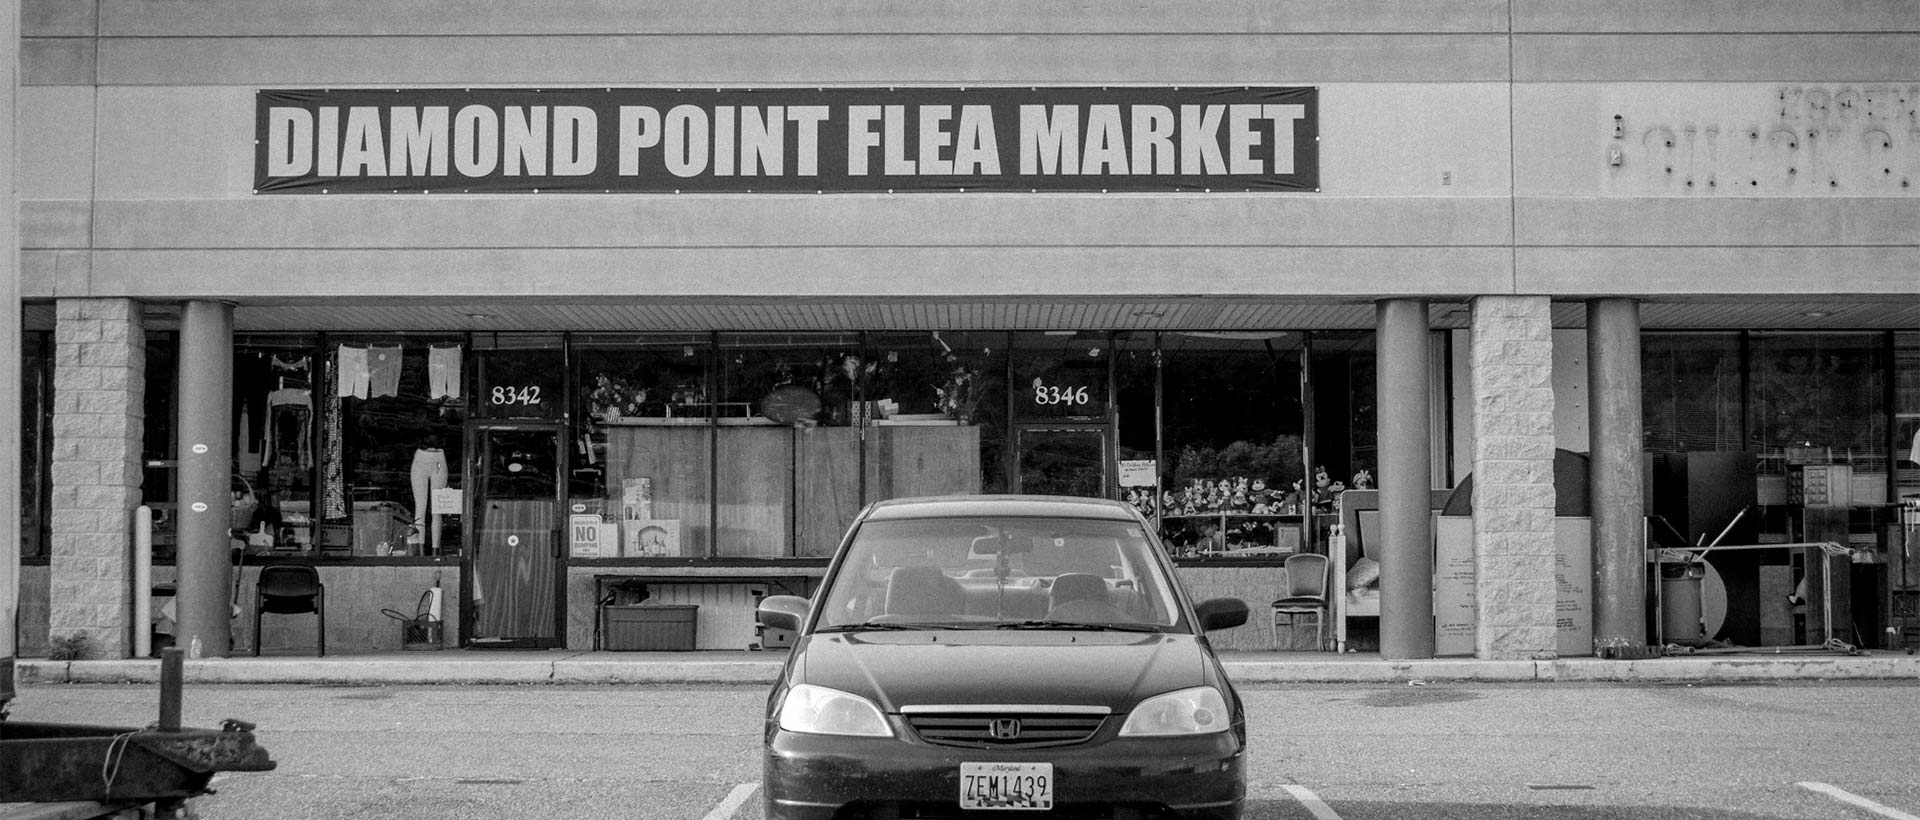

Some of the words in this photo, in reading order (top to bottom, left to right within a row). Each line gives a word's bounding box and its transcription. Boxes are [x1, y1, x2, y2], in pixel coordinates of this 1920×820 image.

[267, 104, 598, 177] DIAMOND
[618, 104, 829, 177] POINT
[847, 104, 1001, 176] FLEA
[1019, 104, 1305, 175] MARKET
[491, 385, 541, 406] 8342
[1035, 385, 1089, 406] 8346
[575, 526, 596, 542] NO
[965, 775, 1047, 799] 7EM1439
